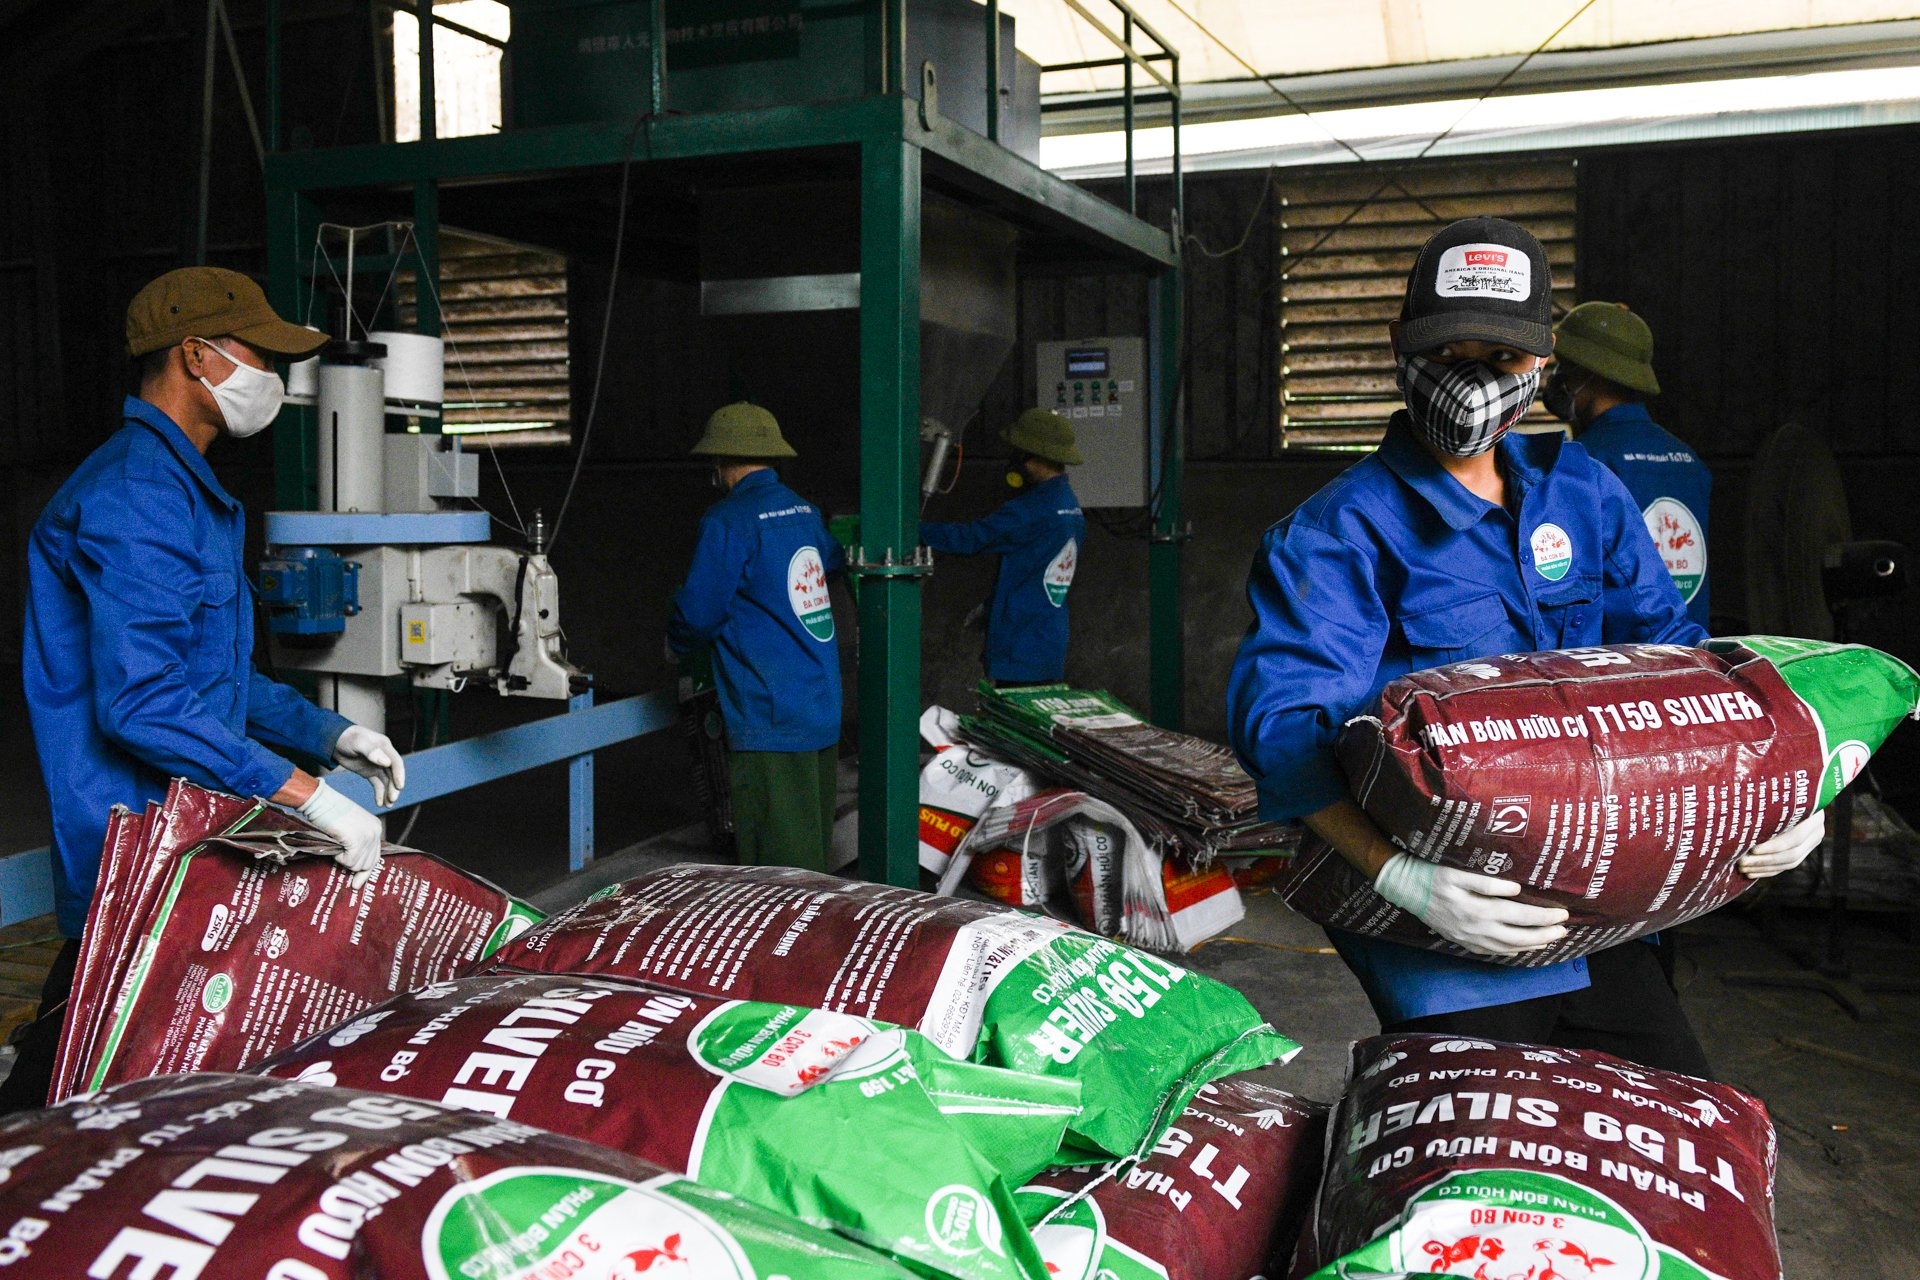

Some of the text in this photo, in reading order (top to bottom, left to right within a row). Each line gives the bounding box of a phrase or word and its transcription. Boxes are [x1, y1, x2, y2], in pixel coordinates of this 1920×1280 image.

[1473, 714, 1517, 743] BÓN
[1517, 713, 1561, 741] HỮU
[1561, 716, 1589, 739] CƠ
[1587, 699, 1662, 734] T159
[1662, 691, 1765, 727] SILVER
[939, 758, 959, 776] CƠ
[976, 776, 999, 797] ÓN
[1719, 785, 1728, 799] Tạo
[1758, 780, 1766, 798] Tăng
[1770, 776, 1778, 790] cho
[1796, 769, 1809, 804] CÔNG
[1628, 796, 1637, 807] Độ
[1655, 793, 1664, 802] Tỷ
[1669, 792, 1678, 808] Chất
[1683, 784, 1698, 826] THÀNH
[1706, 784, 1715, 827] hoạt động và
[1720, 800, 1728, 814] môi
[1731, 781, 1741, 824] cho cây phát
[1745, 782, 1755, 810] Bổ sung
[919, 808, 948, 832] PLUS
[1549, 803, 1559, 818] Bảo
[1562, 803, 1572, 825] Không
[1576, 802, 1586, 825] Không
[1590, 801, 1600, 824] Không
[1586, 794, 1622, 898] CẢNH BÁO AN TOÀN
[1677, 829, 1694, 860] PHẦN
[1484, 851, 1507, 874] ISO
[1667, 861, 1685, 884] ĐỊNH
[288, 876, 307, 907] ISO
[350, 856, 385, 944] CẢNH BÁO AN TOÀN
[207, 914, 223, 939] 25Kg
[253, 921, 271, 955] 14001:2015
[388, 879, 429, 991] THÀNH PHẦN ĐỊNH LƯỢNG
[464, 911, 492, 961] CÔNG DỤNG
[791, 921, 807, 932] SỬ
[267, 926, 285, 958] ISO
[525, 935, 538, 949] CƠ
[534, 932, 553, 952] XUẤT
[268, 971, 277, 982] Cây
[652, 961, 664, 974] Bón
[680, 967, 692, 980] Bón
[880, 961, 894, 979] (VSV)
[962, 957, 975, 975] Liên
[977, 951, 1005, 991] T&T 159
[192, 986, 201, 998] KHU
[289, 978, 298, 989] Cây
[318, 988, 327, 999] Cây
[876, 979, 885, 988] có
[1096, 951, 1187, 1019] T159
[180, 1002, 188, 1014] SAU
[261, 994, 269, 1005] cây
[336, 995, 344, 1006] Cây
[958, 1000, 970, 1020] KĐT
[176, 1015, 184, 1026] THU
[202, 1019, 216, 1038] NHÀ
[766, 1006, 798, 1038] PHÂN
[170, 1026, 180, 1046] HOẠCH
[184, 1016, 206, 1060] PHÂN BÓN
[380, 1005, 472, 1082] PHÂN BÒ
[776, 1029, 813, 1061] 3 CON
[944, 1032, 956, 1048] Lao
[564, 995, 698, 1108] ÓN HỮU CƠ
[858, 1073, 895, 1099] 159
[1388, 1068, 1702, 1129] NGUỒN GỐC TỪ PHÂN BÒ
[1346, 1092, 1560, 1155] SILVER
[1583, 1112, 1745, 1204] T159
[40, 1146, 145, 1214] PHÂN
[1367, 1136, 1706, 1212] PHÂN BÓN HỮU CƠ
[1101, 1163, 1193, 1213] PHÂ
[547, 1185, 597, 1231] PHÂN
[1439, 1186, 1606, 1219] PHÂN BÓN HỮU CƠ
[297, 1170, 401, 1260] HỮU
[950, 1199, 976, 1251] 100%
[1470, 1208, 1566, 1229] 3 CON BÒ
[0, 1216, 50, 1267] BÒ
[577, 1233, 602, 1253] 3
